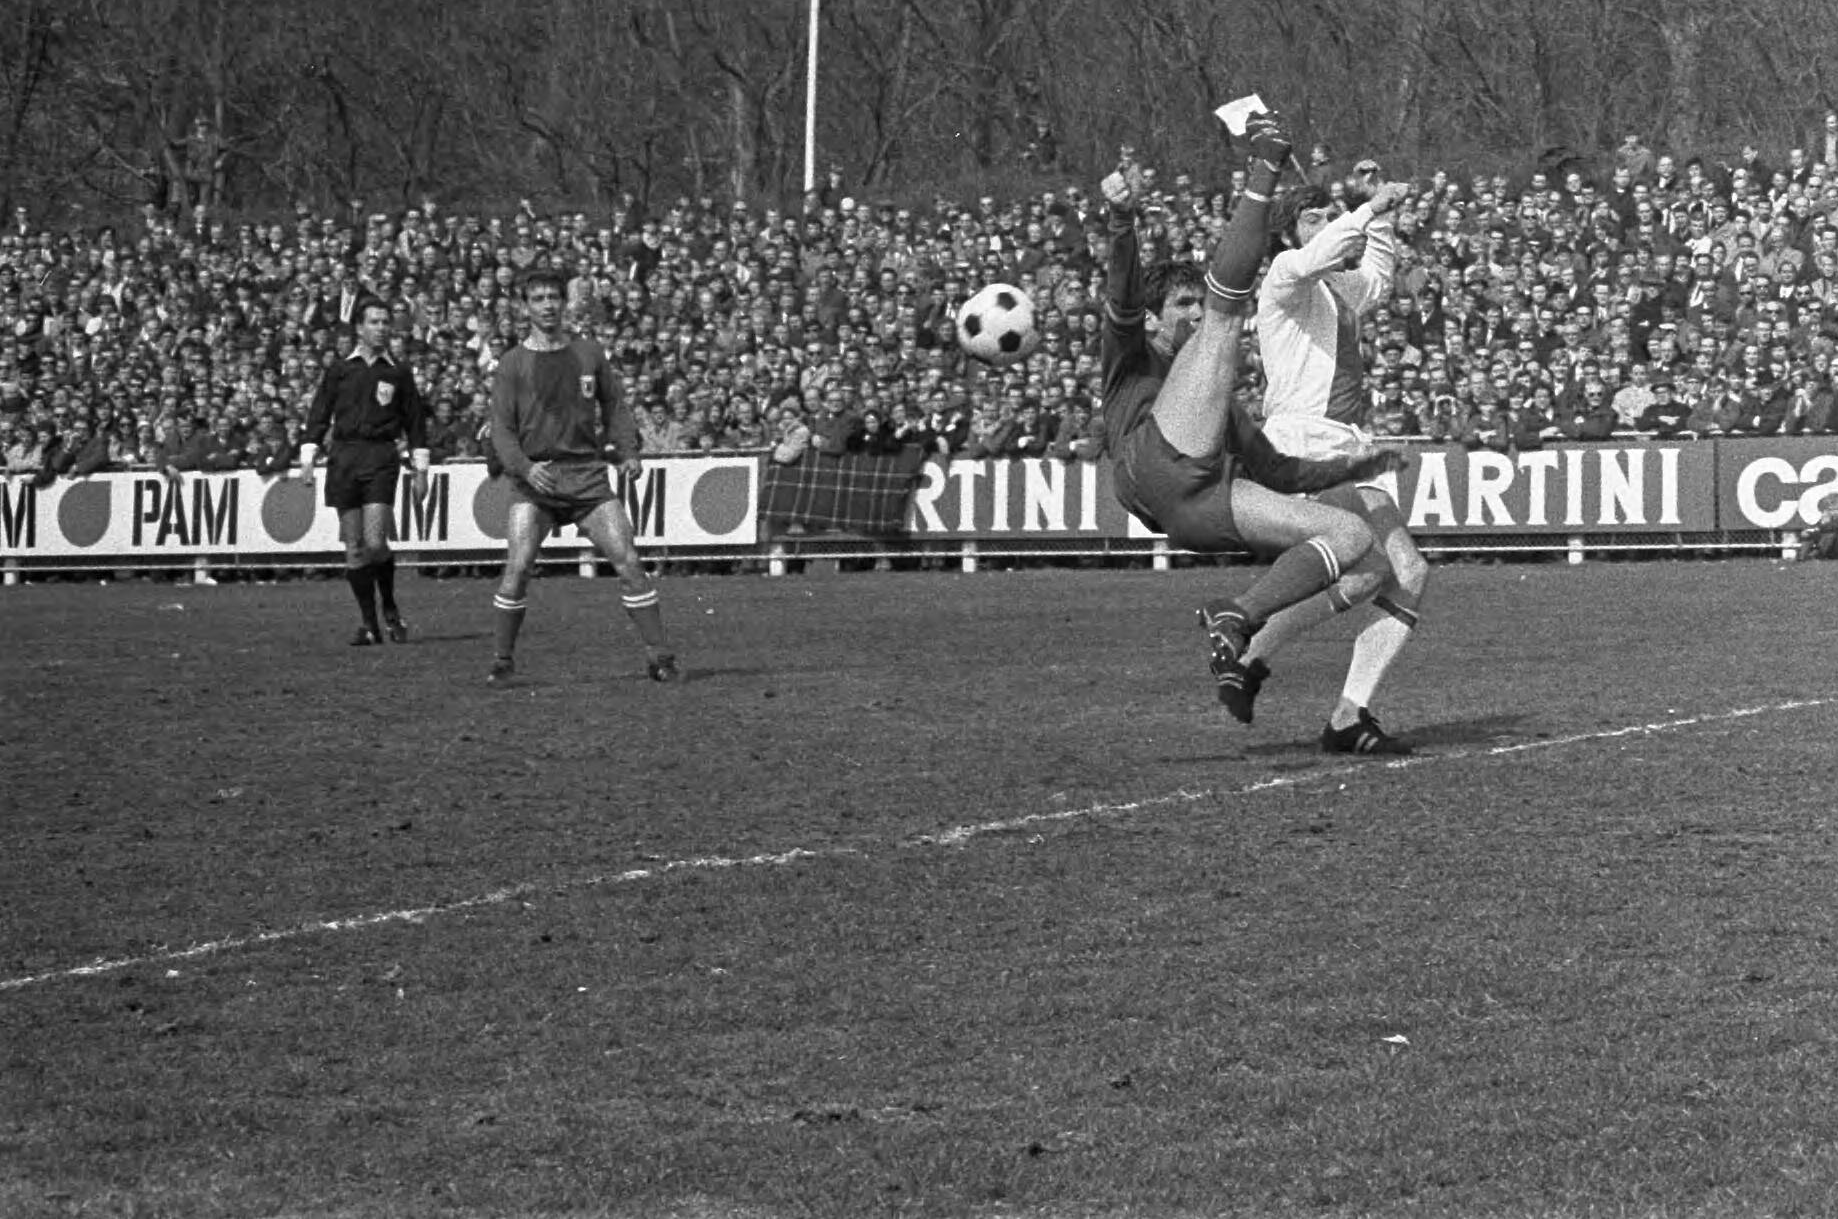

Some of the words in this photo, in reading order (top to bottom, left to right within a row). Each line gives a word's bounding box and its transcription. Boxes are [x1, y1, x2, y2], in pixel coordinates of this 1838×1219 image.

[132, 478, 240, 546] PAM
[911, 458, 1099, 532] RTINI
[1407, 448, 1682, 526] ARTINI
